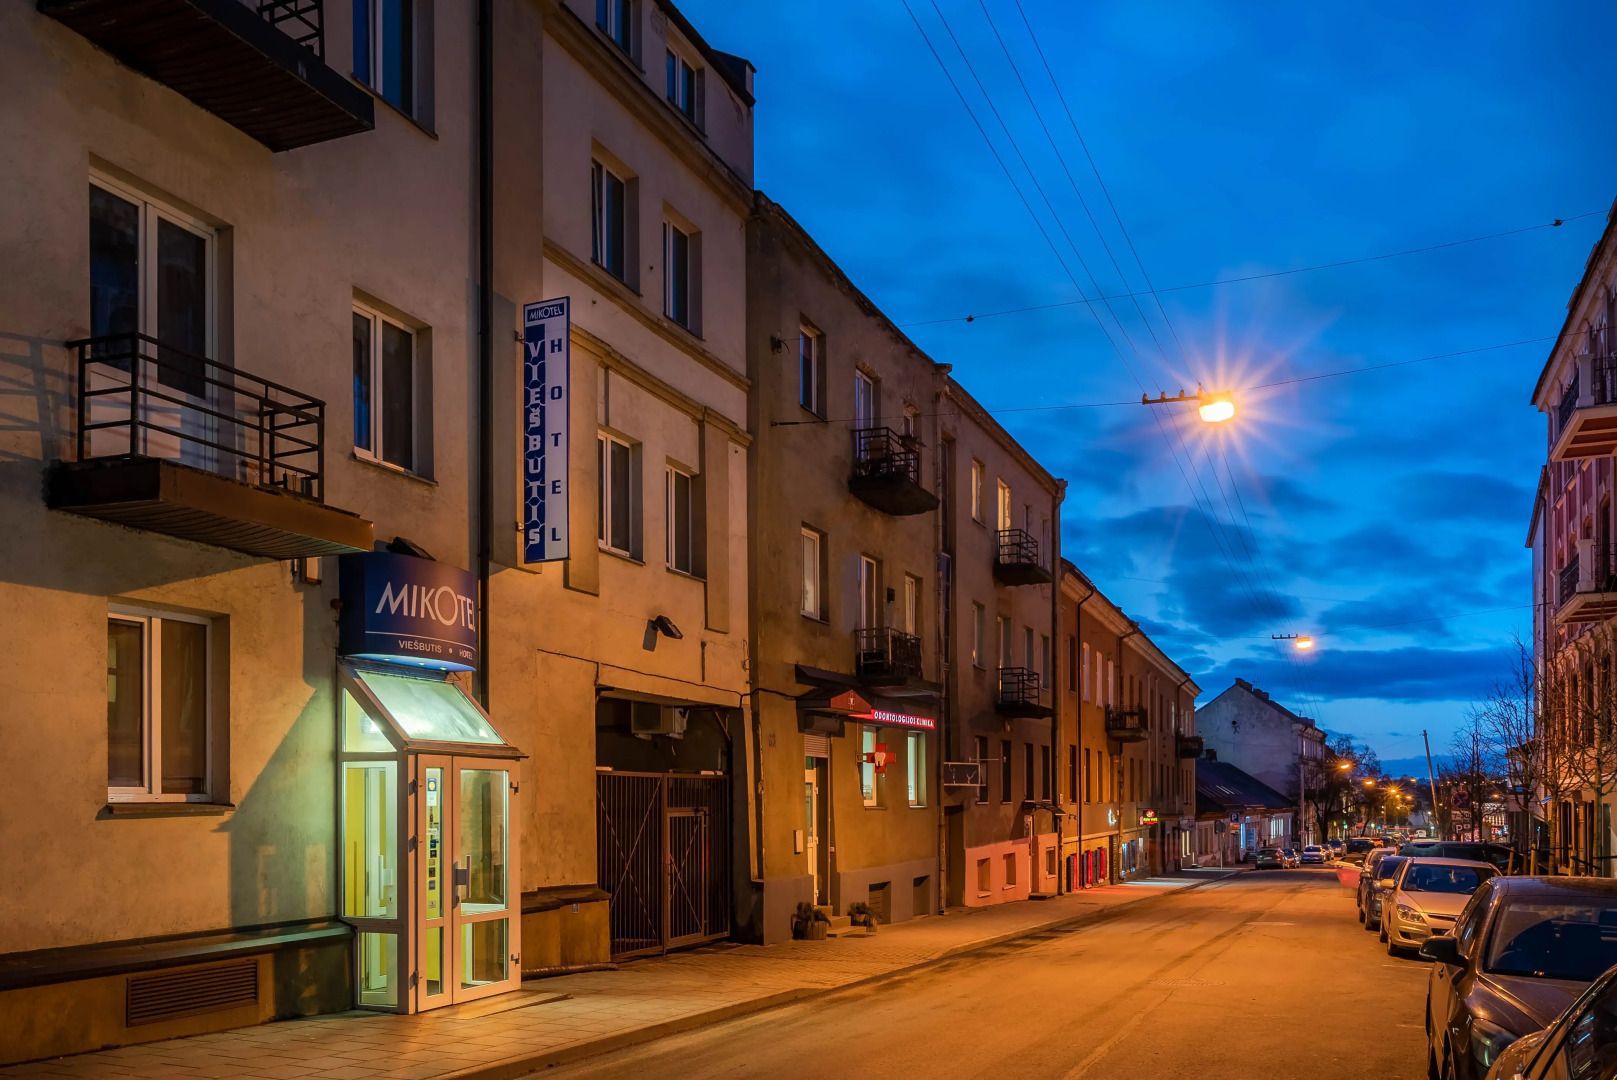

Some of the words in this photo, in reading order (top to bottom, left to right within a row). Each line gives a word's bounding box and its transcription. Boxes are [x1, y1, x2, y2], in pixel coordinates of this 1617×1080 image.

[529, 305, 563, 320] MIKOTEL
[550, 339, 563, 542] HOTEL
[398, 639, 442, 653] VIEŠBUTIS
[459, 649, 473, 660] HOTEL
[874, 711, 916, 725] ODONTOLOGIJOS
[917, 717, 934, 727] KLINIKA
